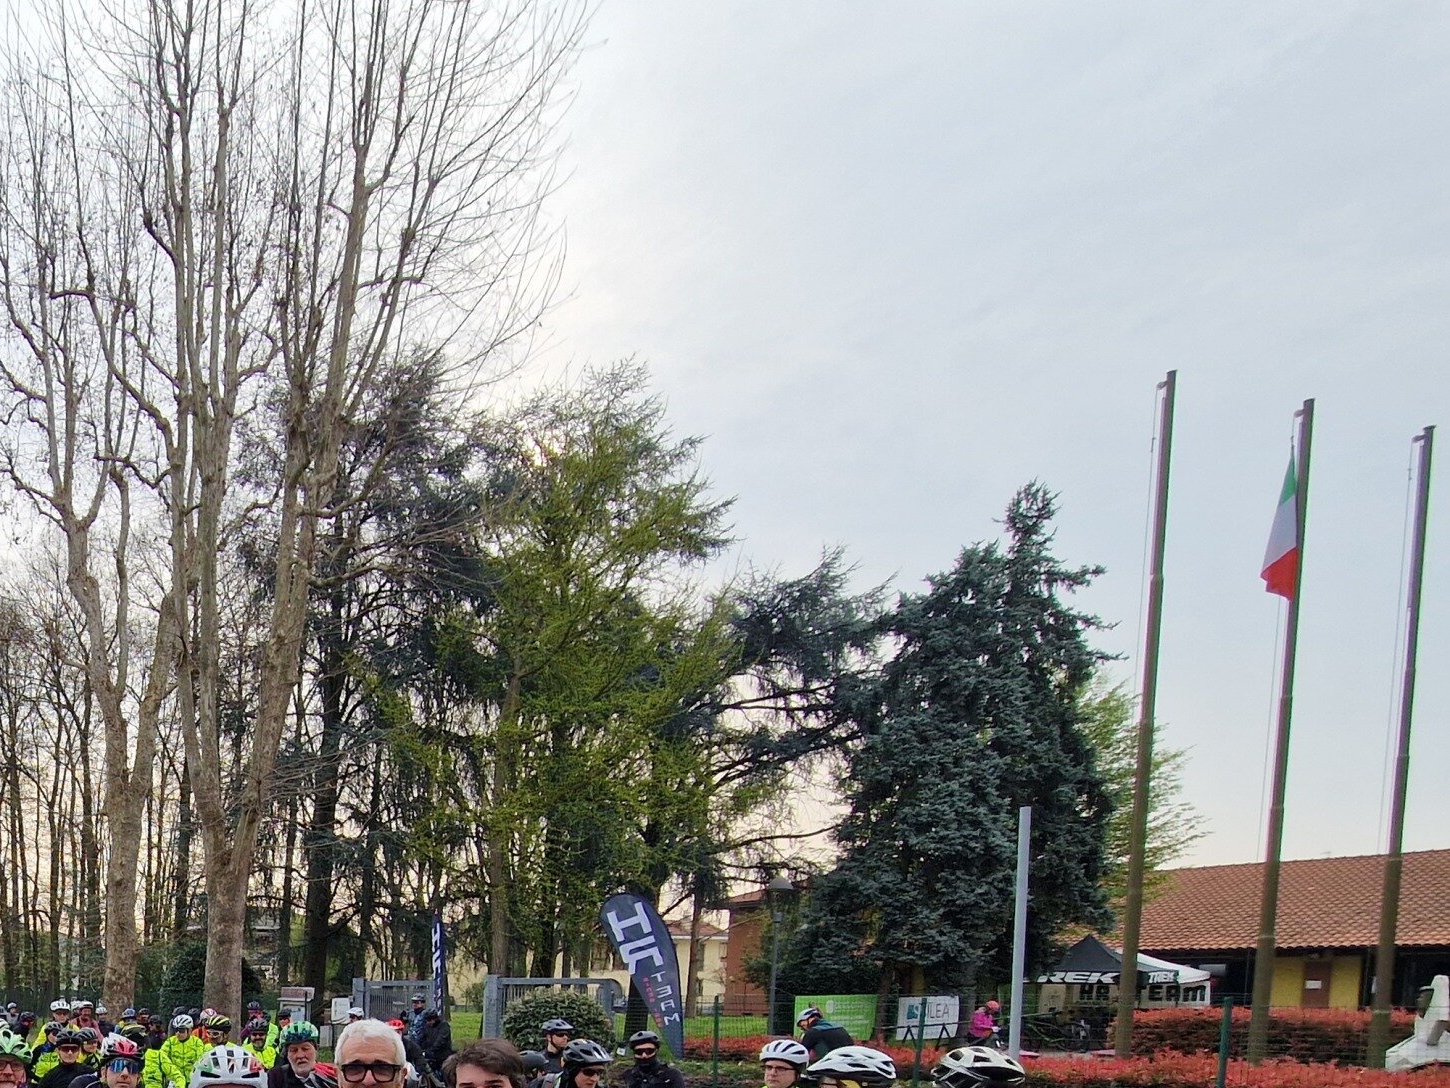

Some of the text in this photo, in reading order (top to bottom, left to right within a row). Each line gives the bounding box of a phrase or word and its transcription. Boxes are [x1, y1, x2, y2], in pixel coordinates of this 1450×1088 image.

[606, 901, 664, 975] HR
[1024, 971, 1120, 984] REK
[1148, 971, 1175, 984] TREK
[651, 970, 680, 1026] TEAM
[921, 1003, 950, 1019] ILEA
